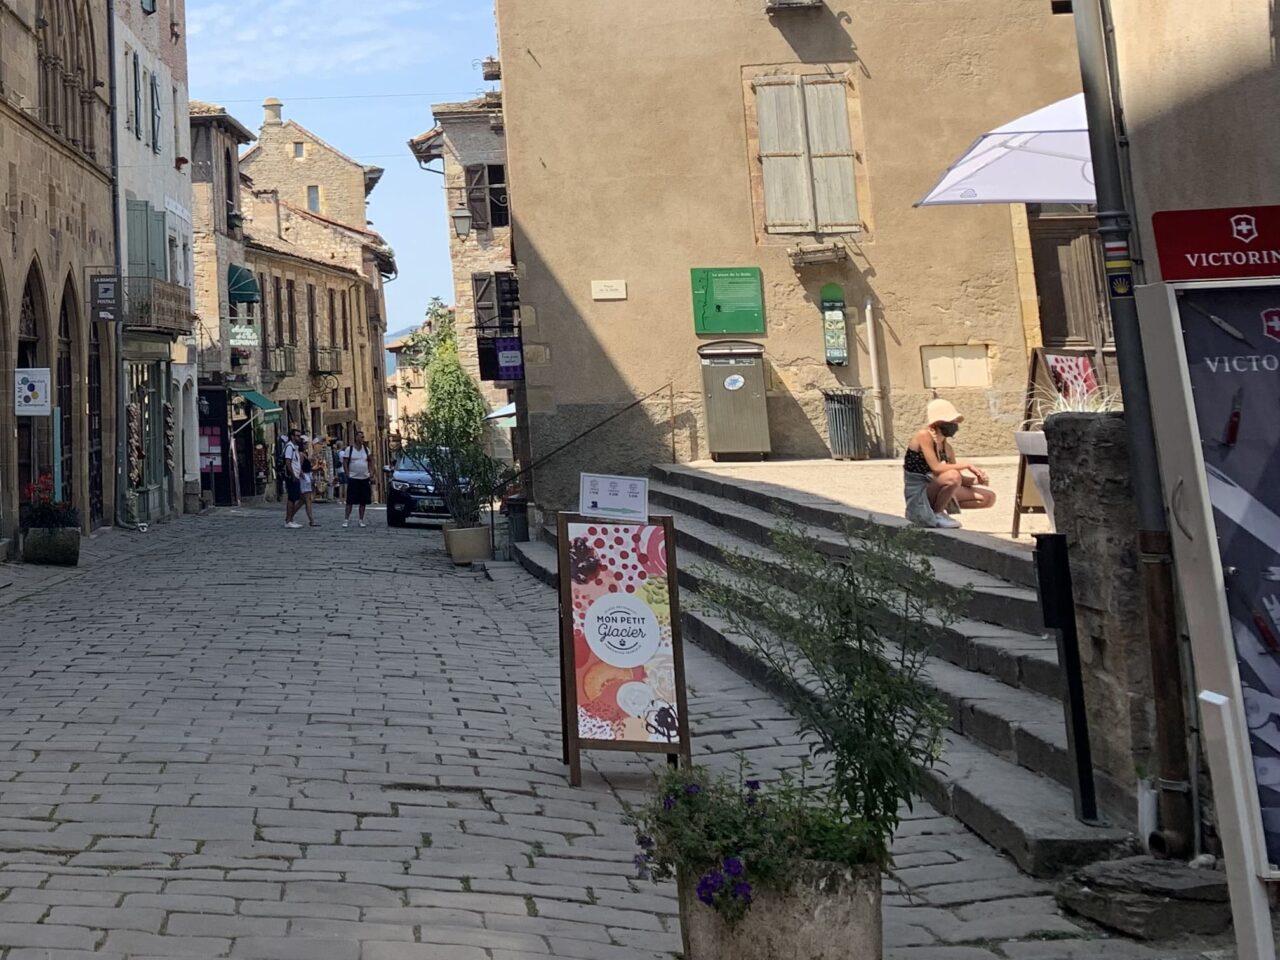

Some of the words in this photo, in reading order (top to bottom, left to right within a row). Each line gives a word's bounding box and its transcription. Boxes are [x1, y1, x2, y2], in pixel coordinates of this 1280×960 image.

[1204, 354, 1279, 373] VICTO
[621, 616, 646, 624] PETIT
[598, 623, 646, 642] Glacier
